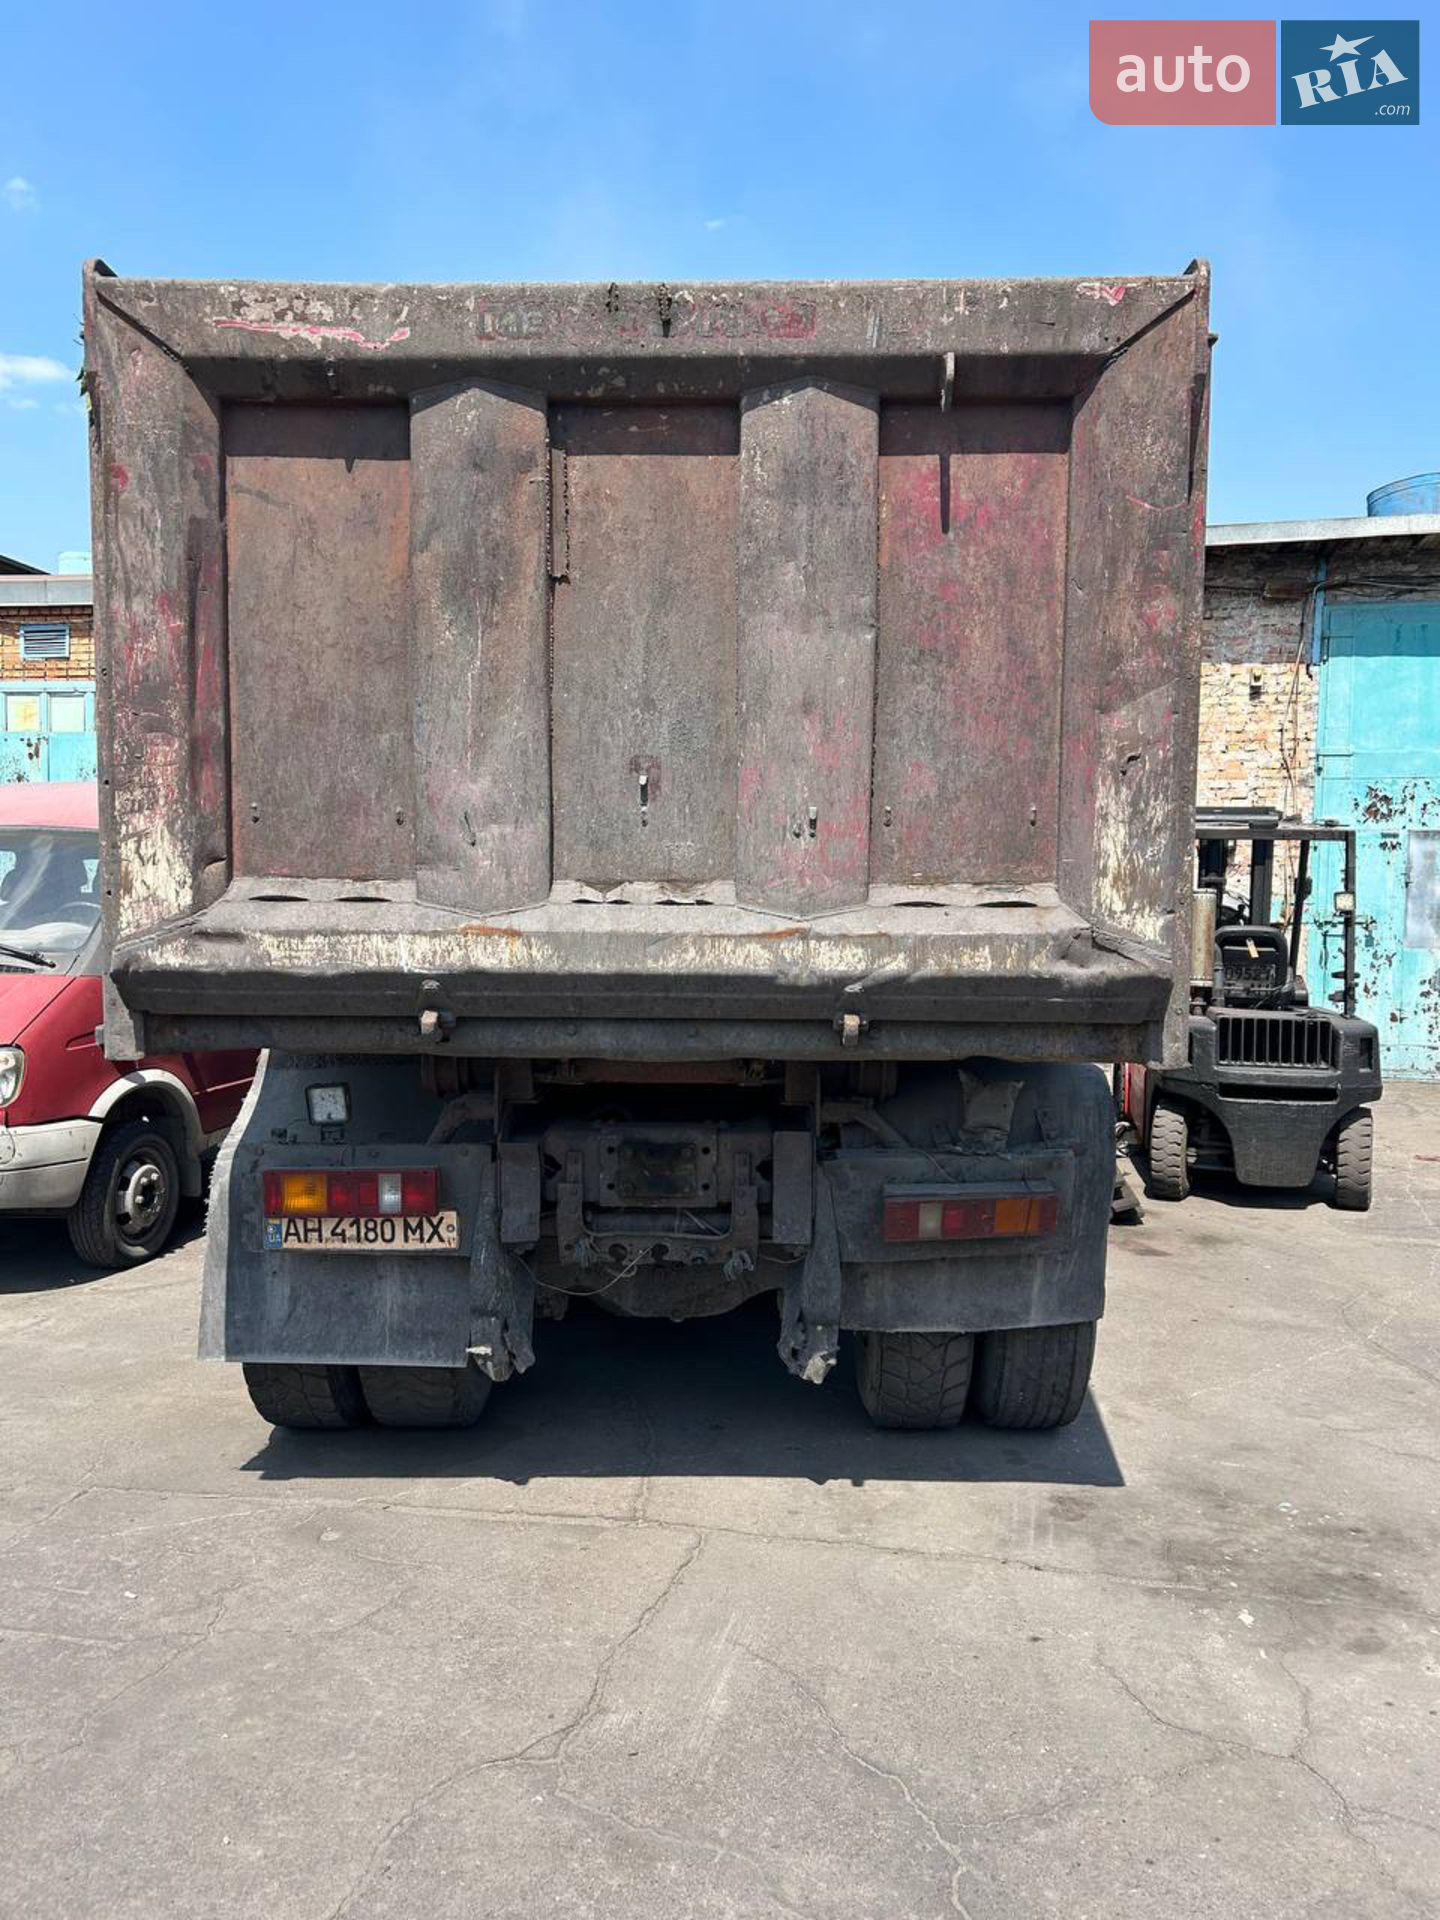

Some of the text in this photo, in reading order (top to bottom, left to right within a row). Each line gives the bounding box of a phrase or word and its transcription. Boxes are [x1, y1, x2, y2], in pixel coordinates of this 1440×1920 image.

[284, 1216, 446, 1244] AH 4180 MX
